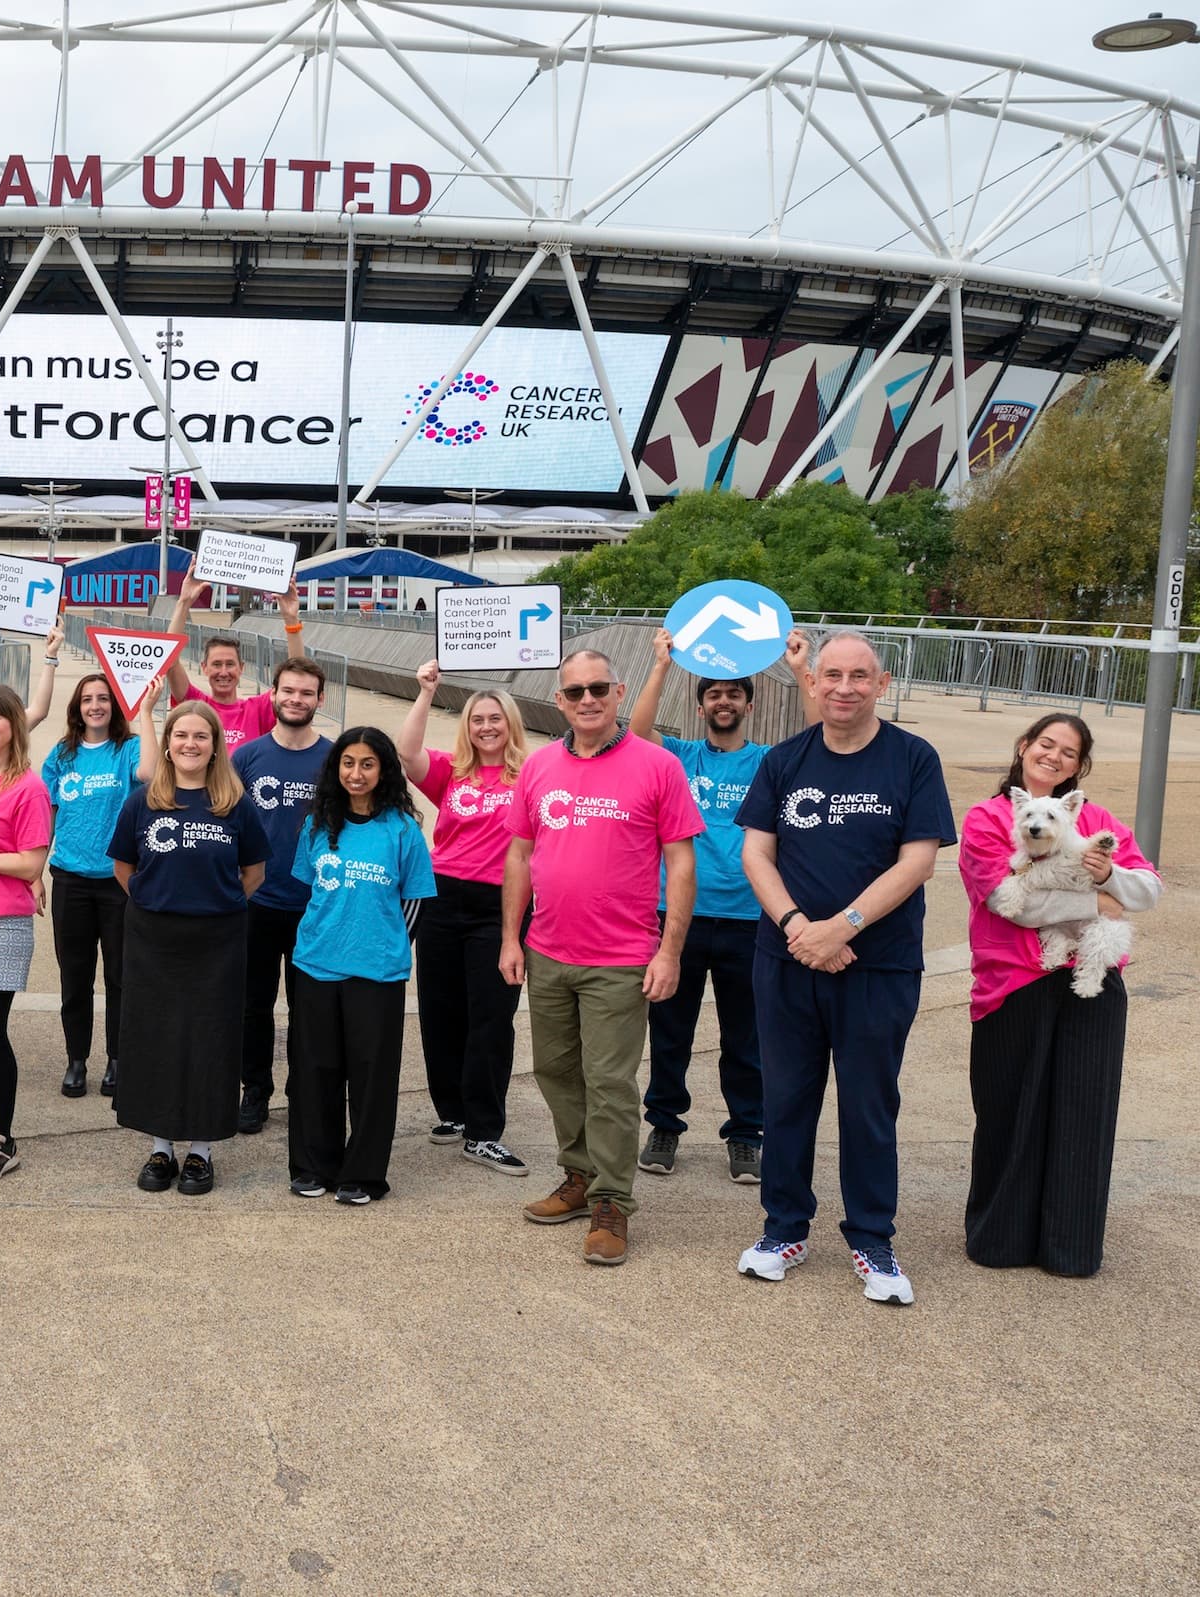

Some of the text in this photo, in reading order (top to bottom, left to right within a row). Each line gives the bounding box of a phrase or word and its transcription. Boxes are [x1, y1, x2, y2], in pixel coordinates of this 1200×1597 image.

[143, 155, 432, 216] UNITED
[162, 351, 220, 381] be
[231, 360, 258, 382] a
[509, 385, 602, 402] CANCER
[992, 404, 1031, 417] WEST HAM
[996, 414, 1019, 422] UNITED
[500, 423, 532, 438] UK
[148, 478, 159, 517] WOR
[178, 478, 186, 518] LIVE
[207, 535, 266, 553] The National
[204, 546, 284, 566] Cancer Plan must
[202, 555, 214, 565] be
[224, 560, 257, 574] turning
[259, 566, 284, 577] point
[0, 571, 19, 584] Plan
[200, 566, 247, 581] for cancer
[71, 574, 159, 604] UNITED
[444, 596, 511, 606] The National
[444, 607, 507, 618] Cancer Plan
[444, 620, 469, 628] must
[471, 619, 485, 628] be
[444, 629, 512, 640] turning point
[108, 641, 164, 658] 35,000
[445, 642, 497, 651] for cancer
[116, 658, 154, 670] voices
[84, 773, 115, 782] CANCER
[83, 780, 122, 788] RESEARCH
[284, 781, 318, 792] CANCE
[718, 782, 751, 794] CANCE
[82, 787, 93, 796] UK
[484, 790, 514, 800] CANCE
[282, 798, 295, 806] UK
[483, 798, 511, 806] RESEA
[575, 796, 619, 809] CANCER
[716, 800, 730, 809] UK
[830, 793, 879, 804] CANCER
[482, 806, 495, 814] UK
[574, 807, 630, 821] RESEARCH
[828, 803, 892, 815] RESEARCH
[573, 817, 587, 827] UK
[827, 814, 845, 825] UK
[183, 822, 224, 834] CANCER
[182, 830, 233, 845] RESEARCH
[182, 839, 197, 848] UK
[345, 859, 386, 875] CANCER
[344, 869, 393, 886] RESEARCH
[344, 879, 357, 889] UK
